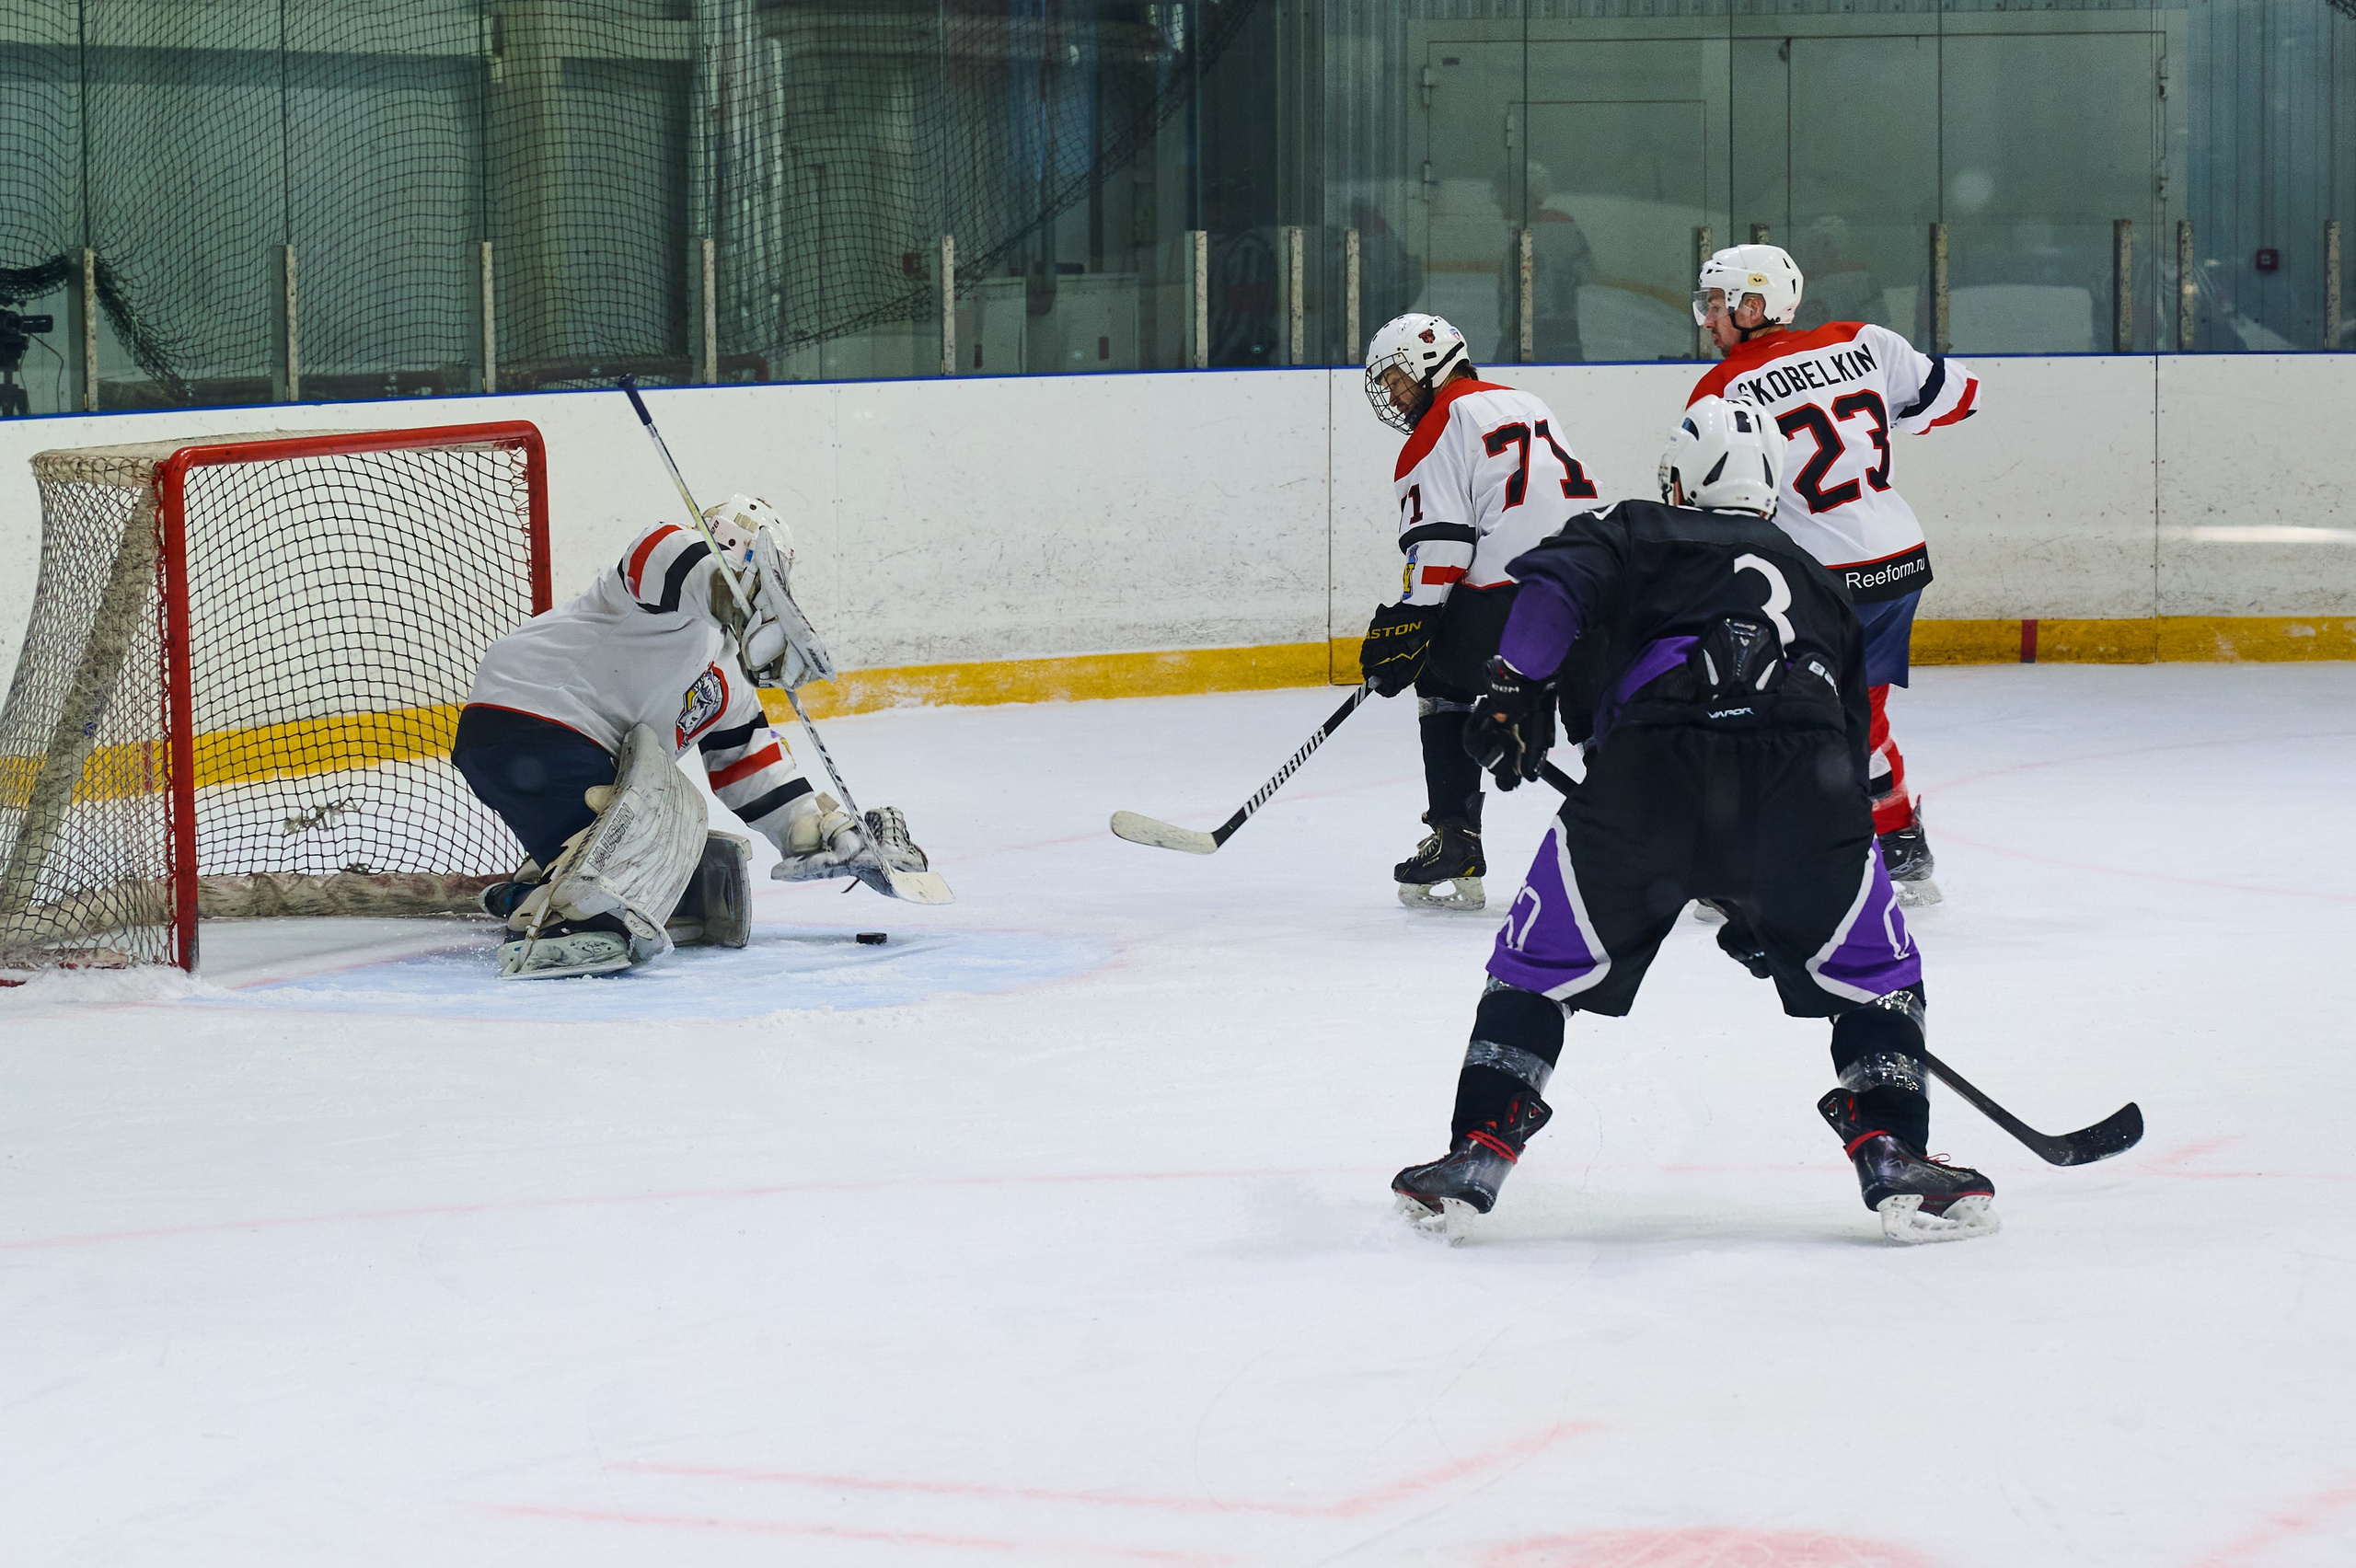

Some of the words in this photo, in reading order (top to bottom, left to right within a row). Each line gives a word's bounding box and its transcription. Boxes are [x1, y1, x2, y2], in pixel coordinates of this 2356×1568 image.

[1482, 419, 1599, 513] 71
[1774, 388, 1892, 514] 23
[1733, 552, 1796, 659] 3
[1845, 557, 1925, 590] Reeform.ru
[1706, 706, 1755, 720] VAPOR
[1242, 726, 1327, 819] WARRIOR
[586, 801, 636, 873] VAUGHN
